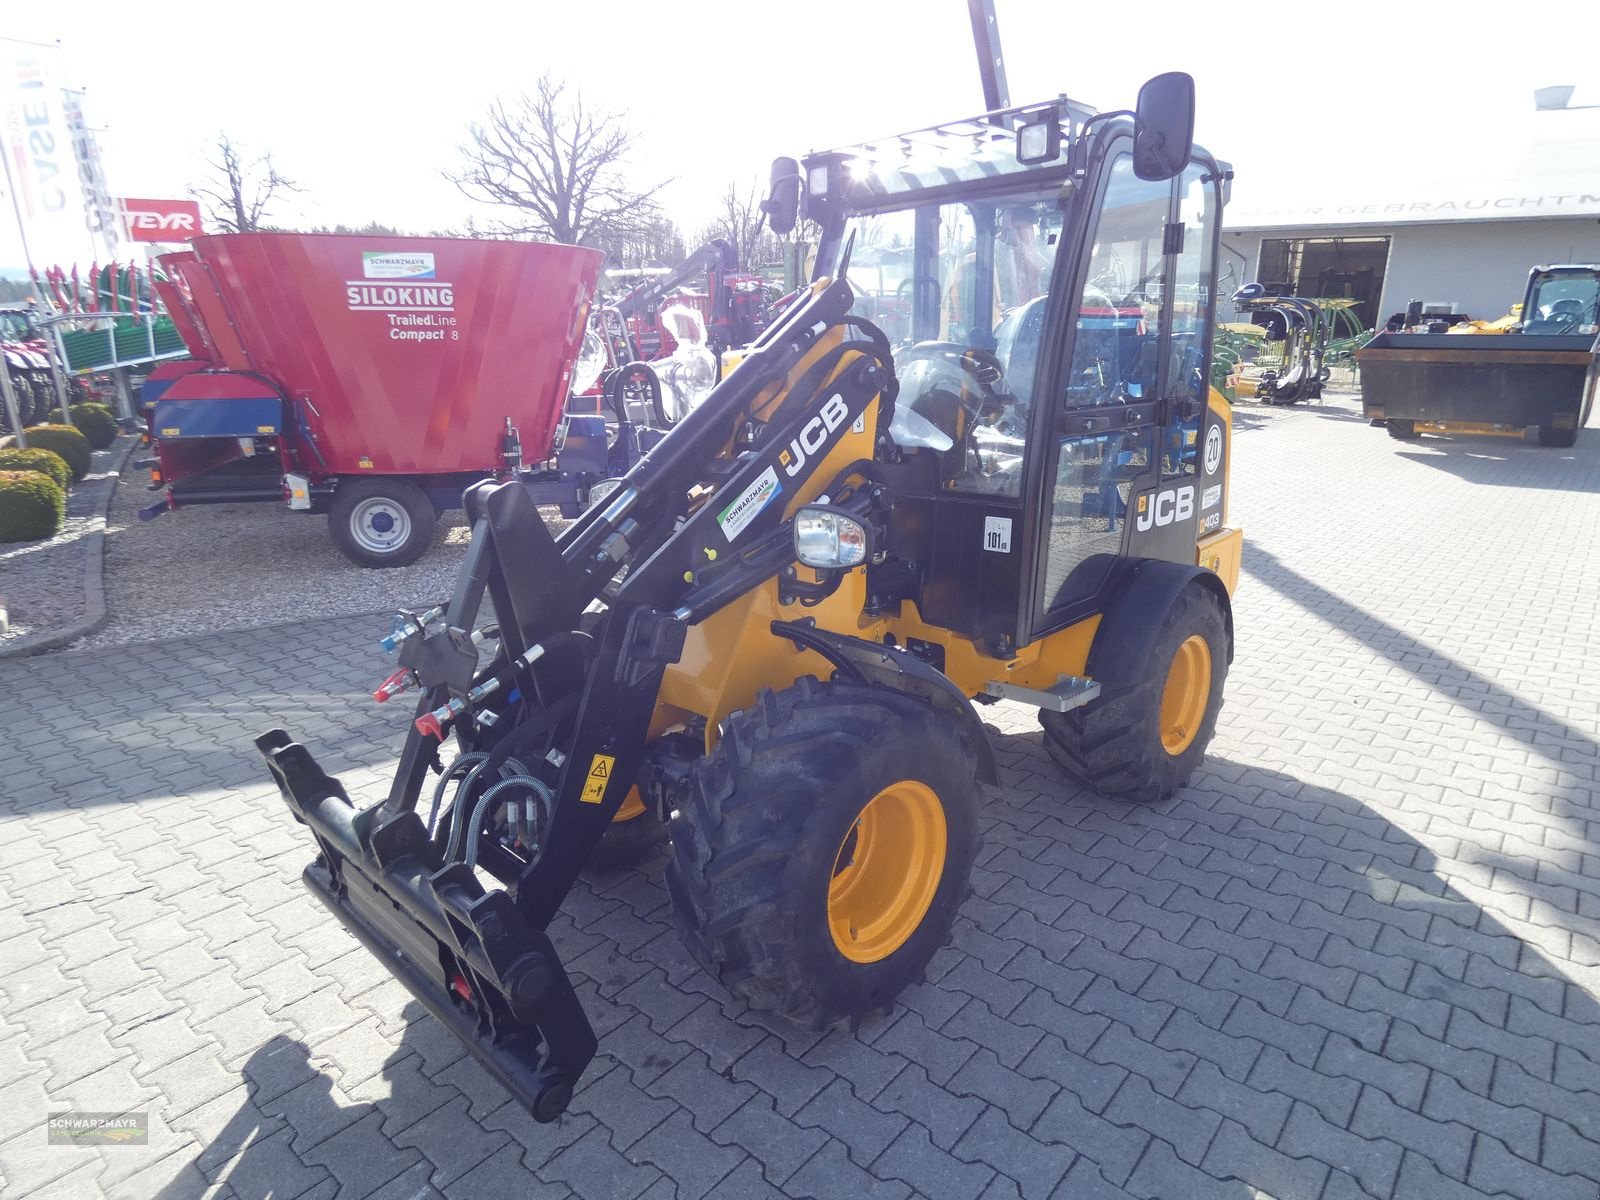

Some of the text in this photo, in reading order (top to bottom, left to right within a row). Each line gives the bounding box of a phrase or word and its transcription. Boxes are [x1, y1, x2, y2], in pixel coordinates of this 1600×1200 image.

[121, 211, 195, 231] TEYR
[347, 287, 454, 306] SILOKING
[387, 313, 457, 326] TrailedLine
[390, 328, 459, 343] Compact 8
[785, 393, 849, 477] JCB
[1207, 436, 1219, 463] 20
[725, 479, 770, 524] SCHWARZMAYR
[1137, 485, 1195, 532] JCB
[1205, 512, 1220, 528] 403
[987, 531, 1001, 549] 101
